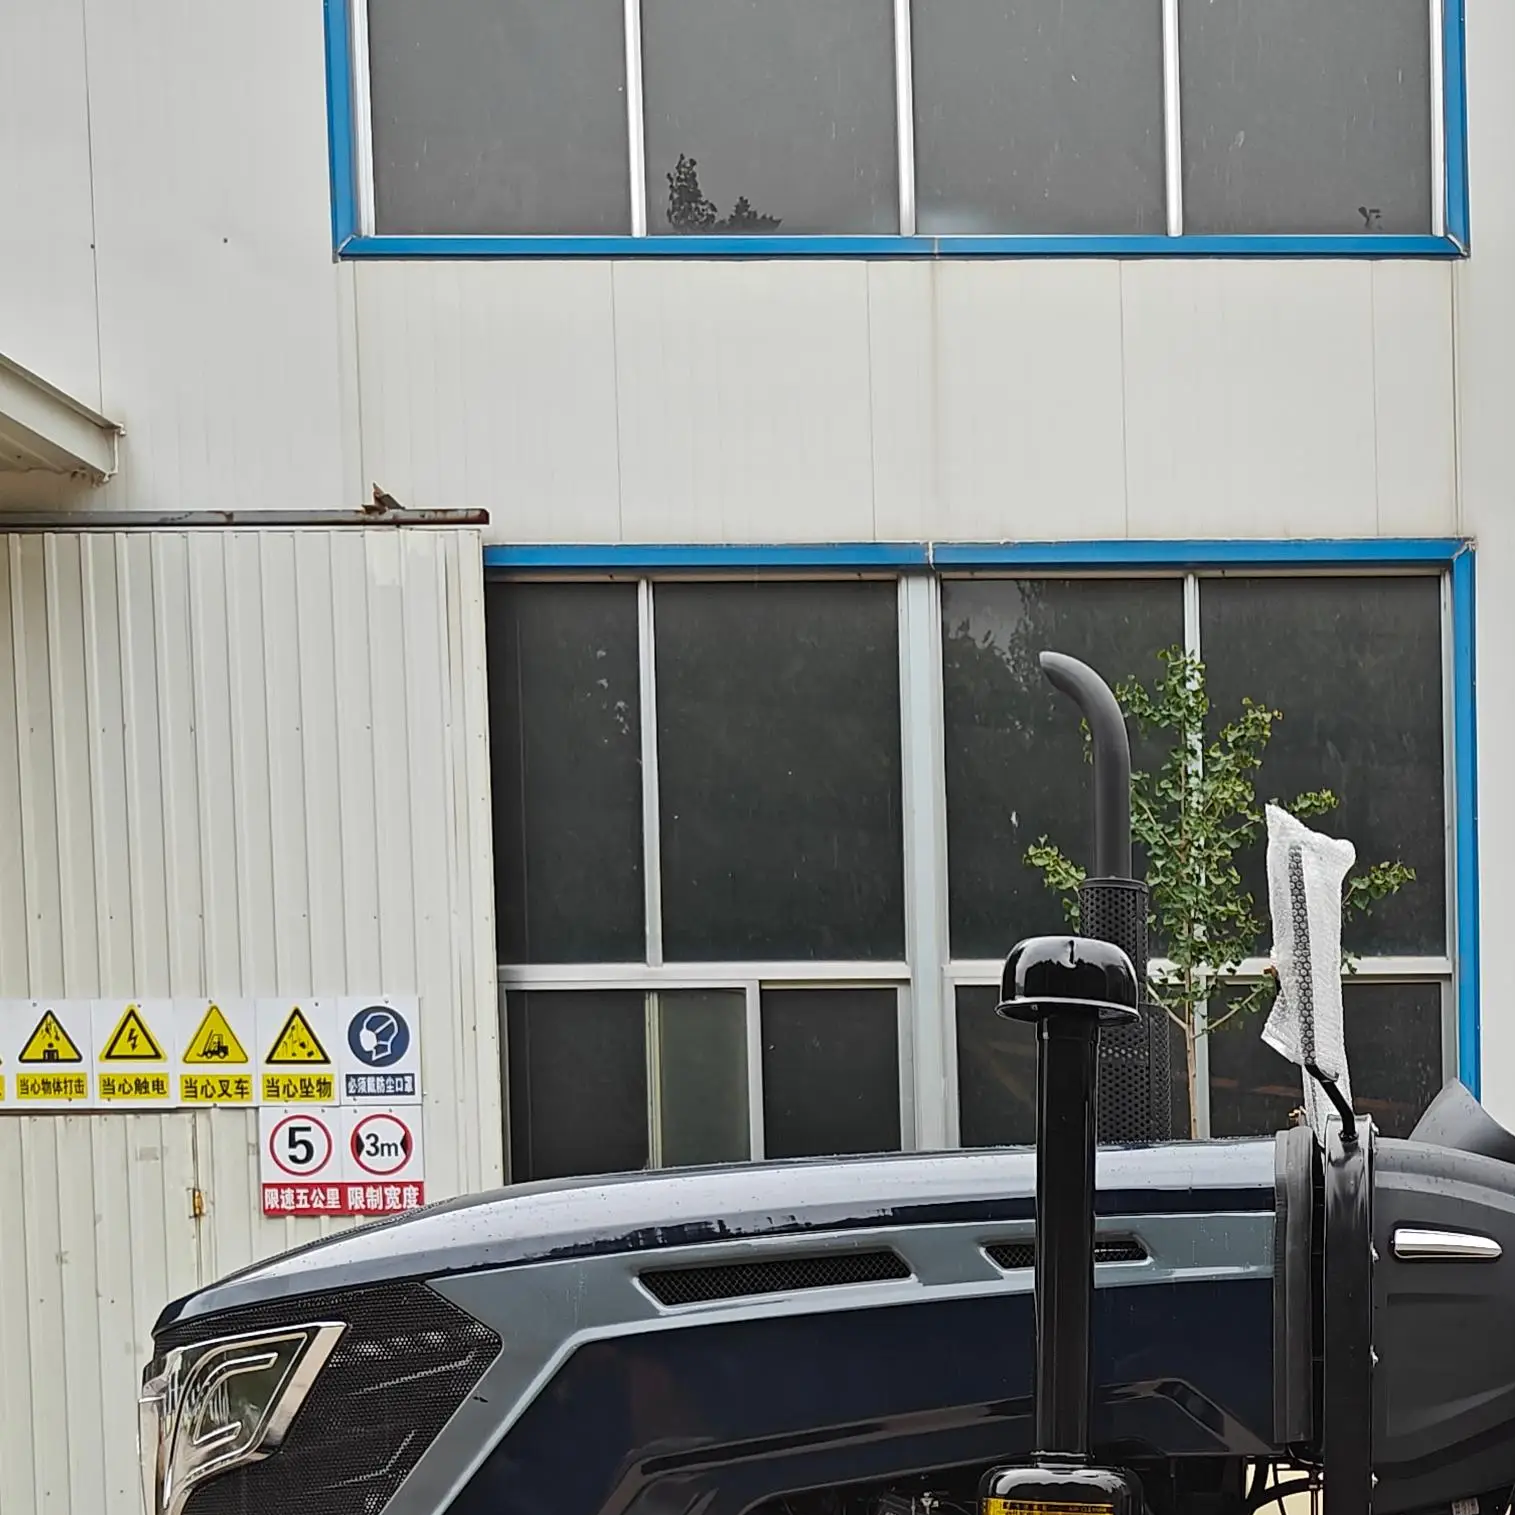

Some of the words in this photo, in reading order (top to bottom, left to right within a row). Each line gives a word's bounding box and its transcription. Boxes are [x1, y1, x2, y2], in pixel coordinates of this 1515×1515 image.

[19, 1077, 85, 1095] 当心物体打击
[102, 1077, 167, 1095] 当心触电
[183, 1077, 250, 1099] 当心叉车
[265, 1077, 332, 1099] 当心坠物
[348, 1075, 414, 1094] 必须戴防尘口罩
[288, 1126, 314, 1165] 5
[365, 1133, 399, 1157] 3m
[264, 1187, 341, 1210] 限速五公里
[347, 1184, 420, 1210] 限制宽度
